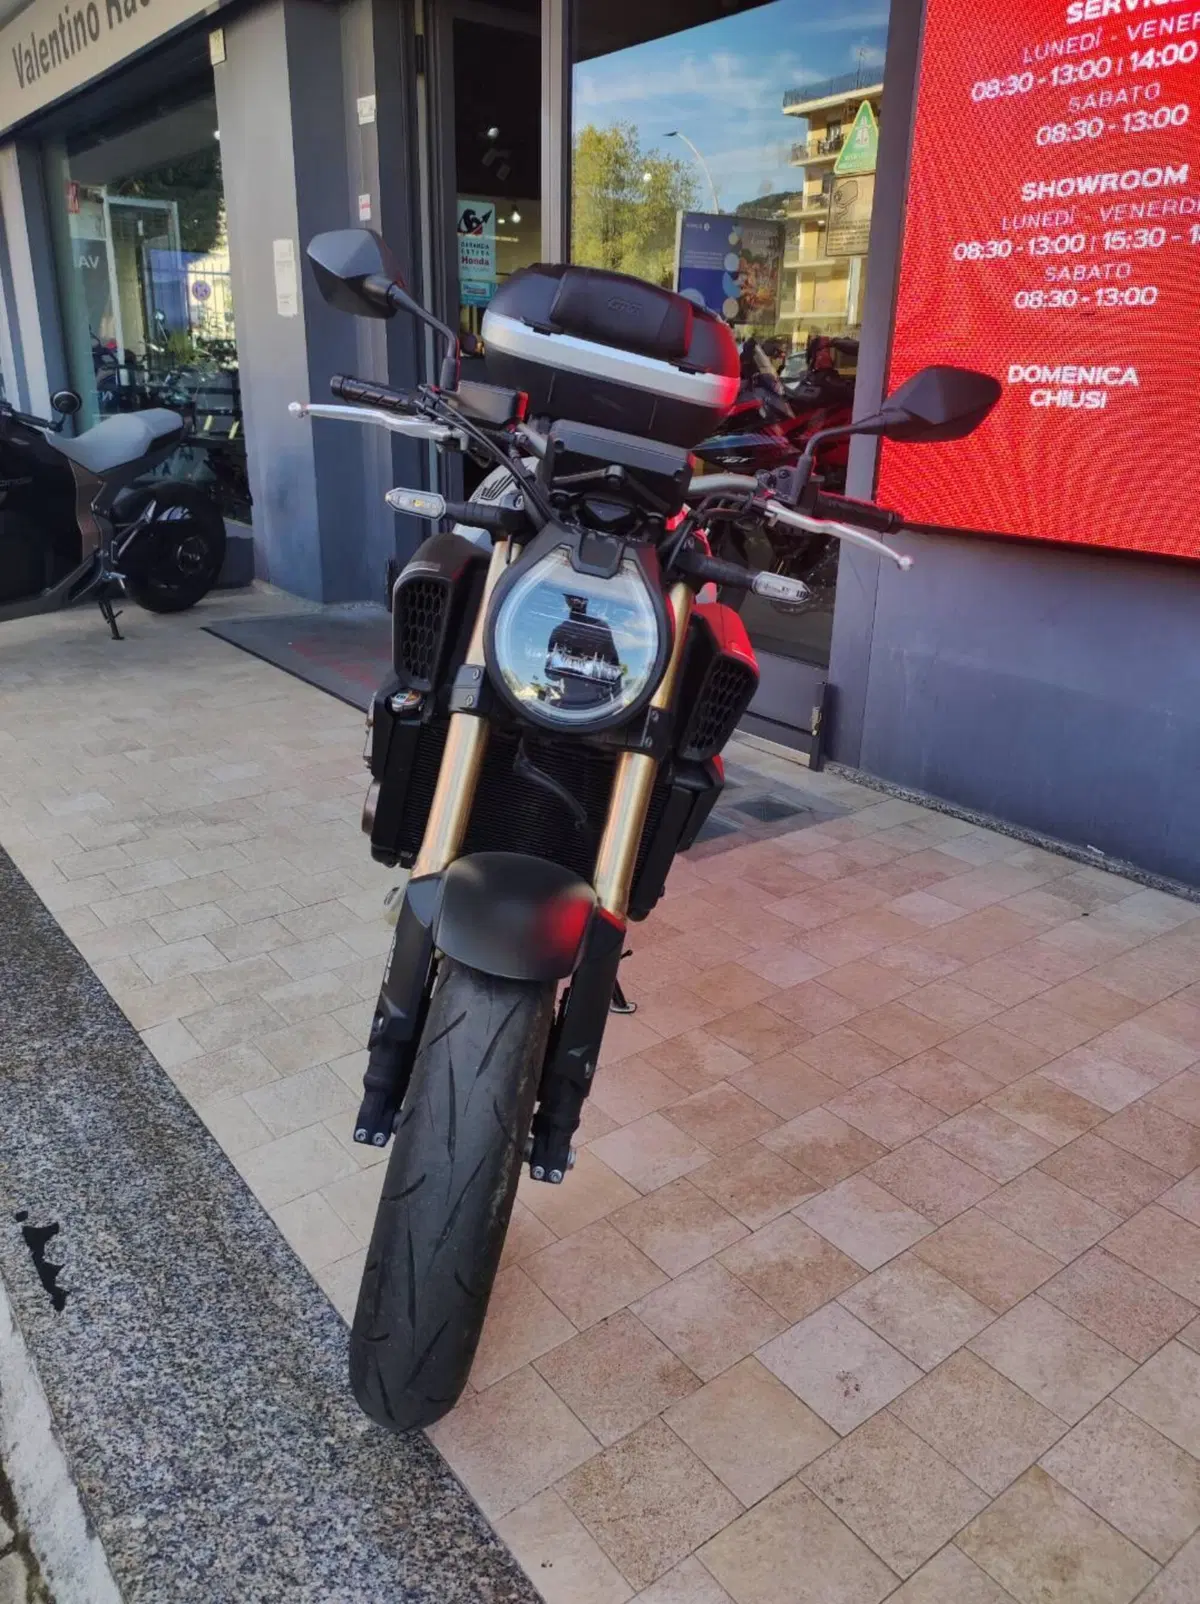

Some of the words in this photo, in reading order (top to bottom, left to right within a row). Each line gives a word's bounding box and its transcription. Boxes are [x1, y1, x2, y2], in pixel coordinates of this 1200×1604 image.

[12, 2, 100, 89] Valentino
[971, 71, 1034, 102] 08:30
[1051, 56, 1112, 87] 13:00
[1130, 40, 1198, 73] 14:00
[1067, 82, 1160, 114] SABATO
[1036, 116, 1104, 146] 08:30
[1122, 103, 1190, 134] 13:00
[1020, 163, 1189, 202] SHOWROOM
[461, 256, 490, 266] Honda
[953, 239, 1013, 261] 08:30
[1028, 233, 1086, 256] 13:00
[1044, 262, 1132, 282] SABATO
[1014, 289, 1078, 309] 08:30
[1096, 286, 1159, 306] 13:00
[1008, 364, 1140, 386] DOMENICA
[1029, 388, 1108, 409] CHIUSI
